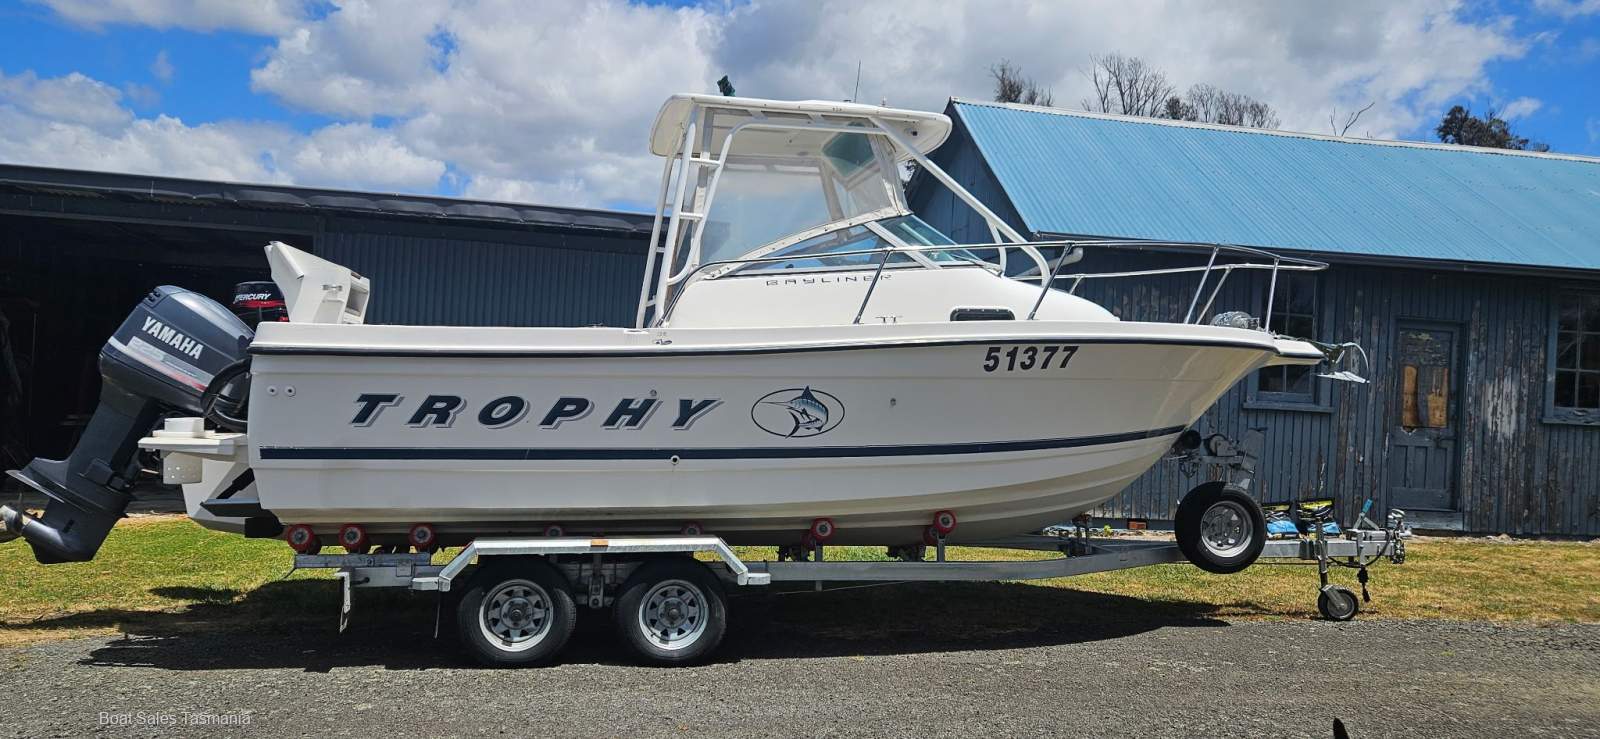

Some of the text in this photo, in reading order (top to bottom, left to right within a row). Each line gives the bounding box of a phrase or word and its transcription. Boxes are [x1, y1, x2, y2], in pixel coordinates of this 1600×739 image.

[766, 274, 892, 287] BAYLINER
[141, 316, 204, 360] YAMAHA
[983, 345, 1080, 372] 51377
[350, 393, 725, 431] TROPHY
